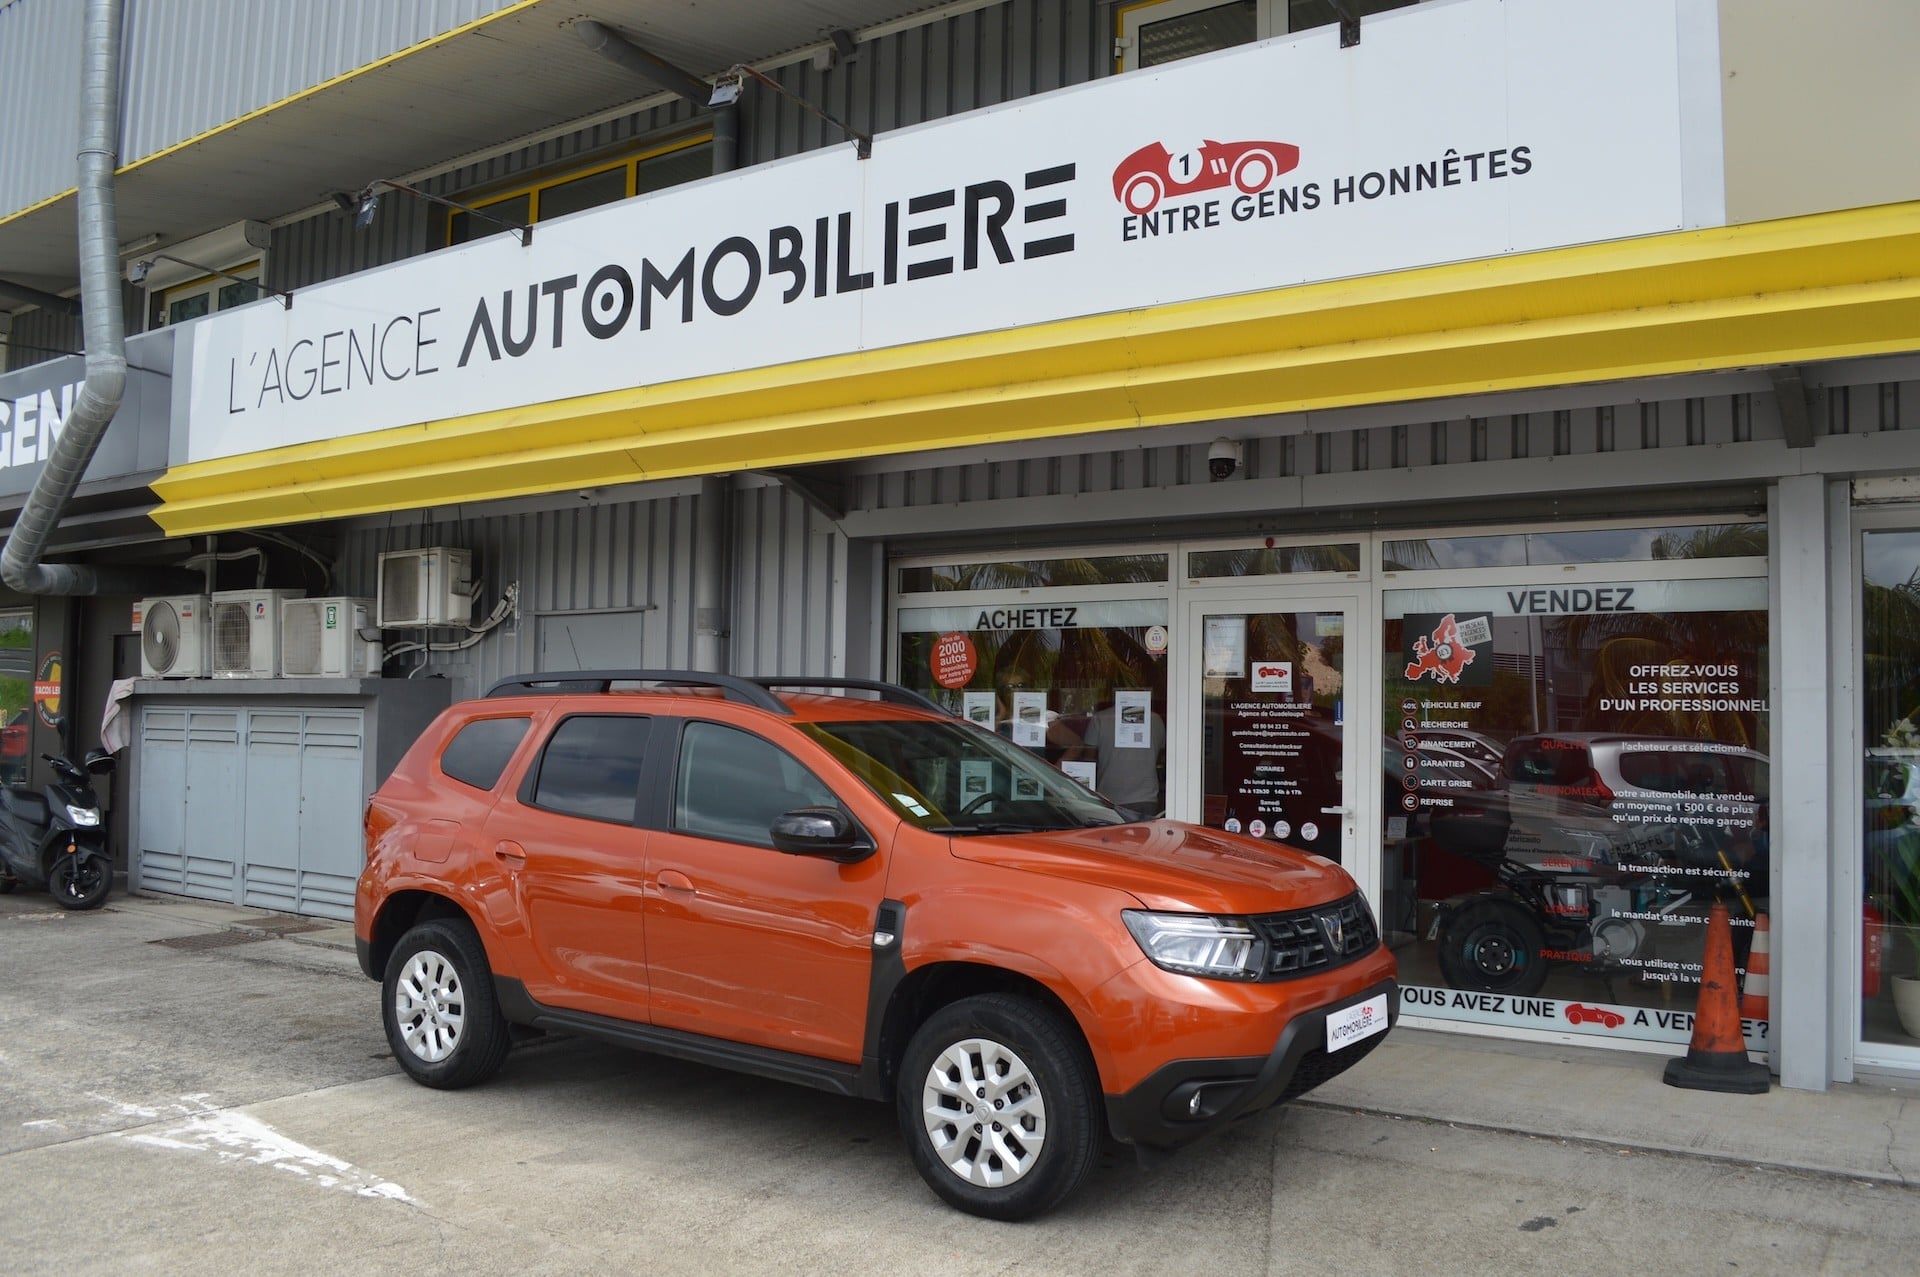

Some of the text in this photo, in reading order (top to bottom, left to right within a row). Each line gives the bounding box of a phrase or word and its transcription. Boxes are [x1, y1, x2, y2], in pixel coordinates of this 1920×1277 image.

[1122, 146, 1532, 241] ENTRE GENS HONNÊTES
[230, 163, 1076, 414] L'AGENCE AUTOMOBILIERE
[1507, 588, 1635, 613] VENDEZ
[976, 607, 1078, 630] ACHETEZ
[939, 640, 966, 657] 2000
[940, 653, 967, 666] autos
[1629, 665, 1739, 677] OFFREZ-VOUS
[1629, 682, 1740, 694] LES SERVICES
[1600, 699, 1769, 712] D'UN PROFESSIONNEL
[1420, 721, 1469, 729] RECHERCHE
[1420, 740, 1477, 748] FINANCEMENT
[1622, 742, 1747, 753] l'acheteur est sélectionné
[1420, 760, 1465, 768] GARANTIES
[1420, 779, 1447, 787] CARTE
[1612, 790, 1755, 801] votre automobile est vendue
[1420, 799, 1454, 807] REPRISE
[1612, 802, 1625, 810] en
[1627, 802, 1673, 812] moyenne
[1684, 803, 1705, 812] 500
[1707, 804, 1714, 812] €
[1716, 804, 1730, 813] de
[1732, 805, 1754, 815] plus
[1612, 814, 1753, 828] qu'un prix de reprise garage
[1618, 863, 1750, 878] la transaction est sécurisée
[1612, 909, 1621, 918] le
[1622, 910, 1661, 920] mandat
[1662, 914, 1678, 922] est
[1539, 949, 1593, 962] PRATIQUE
[1619, 958, 1704, 971] vous utilisez votr
[1642, 970, 1678, 983] jusqu'à
[1680, 973, 1689, 982] la
[1398, 987, 1446, 1007] OUS
[1451, 993, 1505, 1013] AVEZ
[1512, 998, 1555, 1018] UNE
[1633, 1010, 1649, 1027] A
